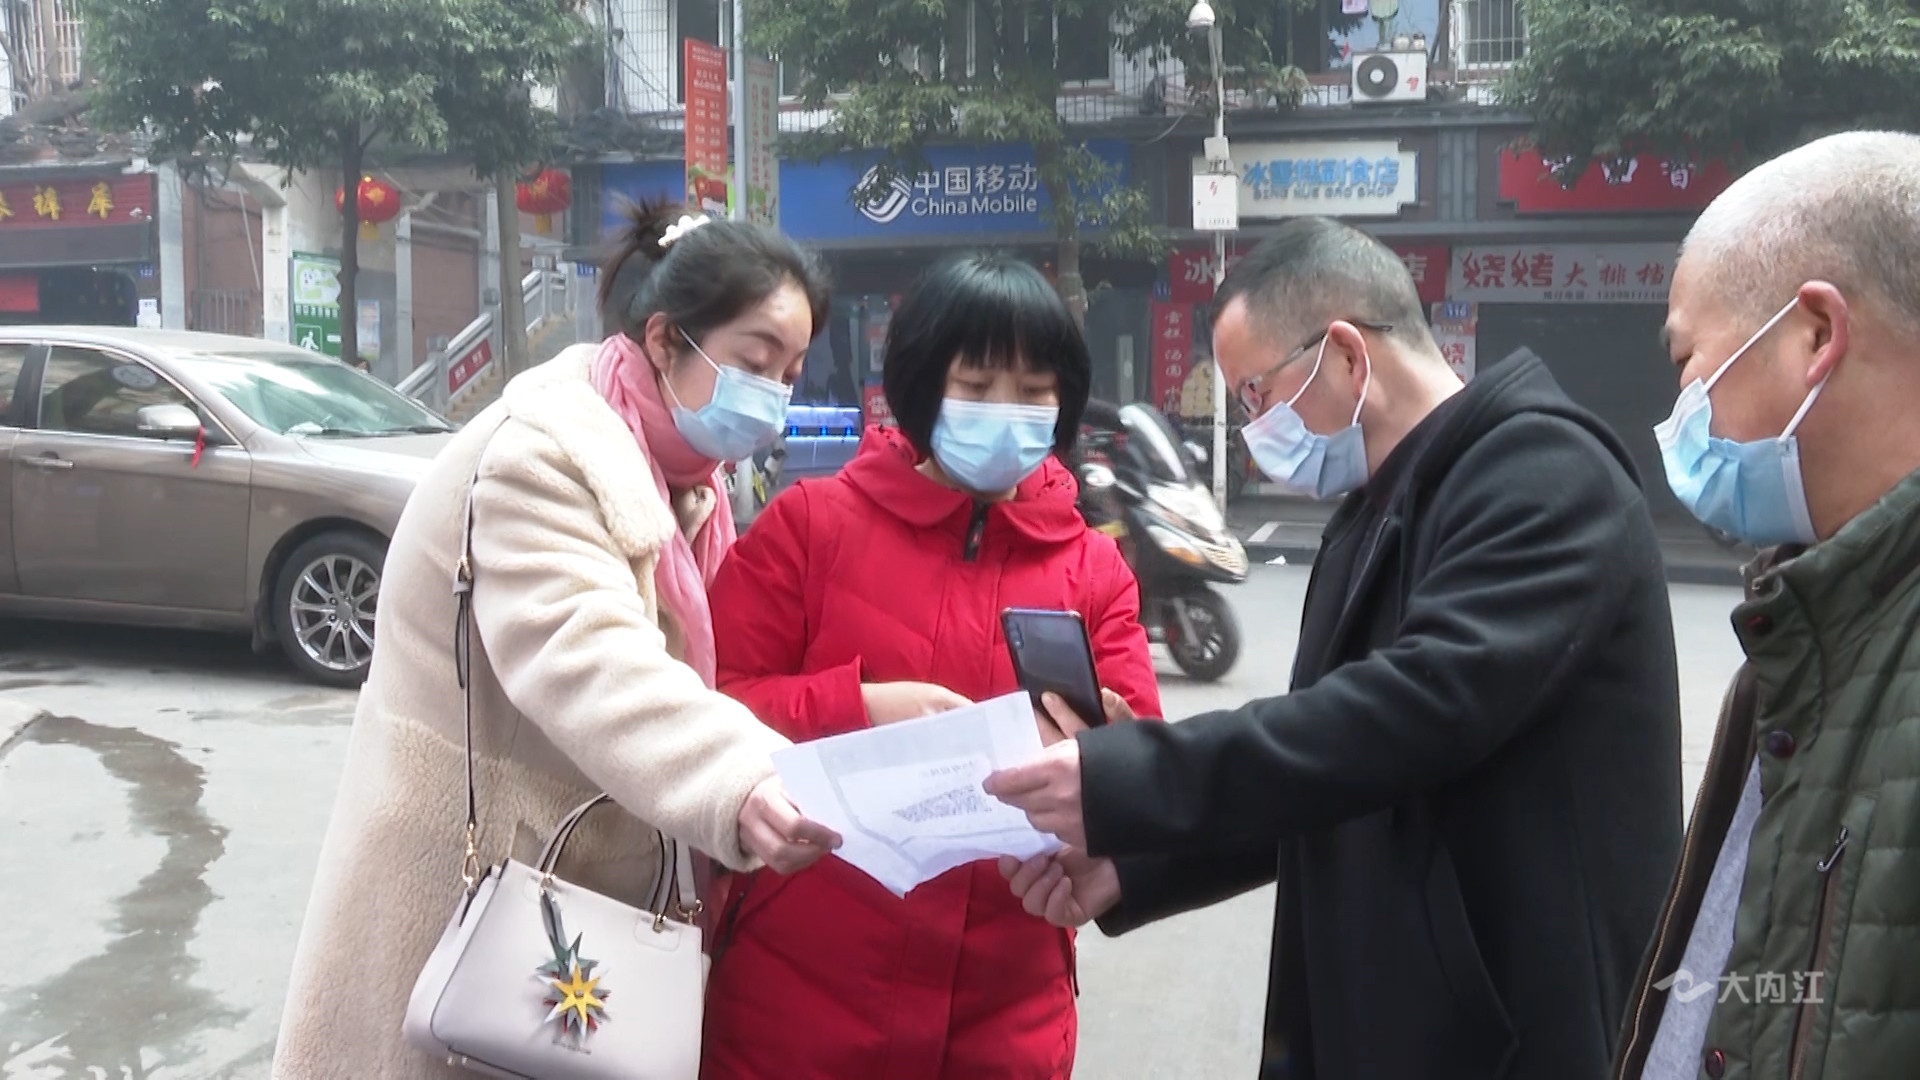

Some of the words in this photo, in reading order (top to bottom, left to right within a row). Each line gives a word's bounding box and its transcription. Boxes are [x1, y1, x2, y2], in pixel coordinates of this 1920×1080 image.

[914, 162, 1038, 196] 中国移动
[911, 198, 968, 216] China
[971, 194, 1038, 214] Mobile
